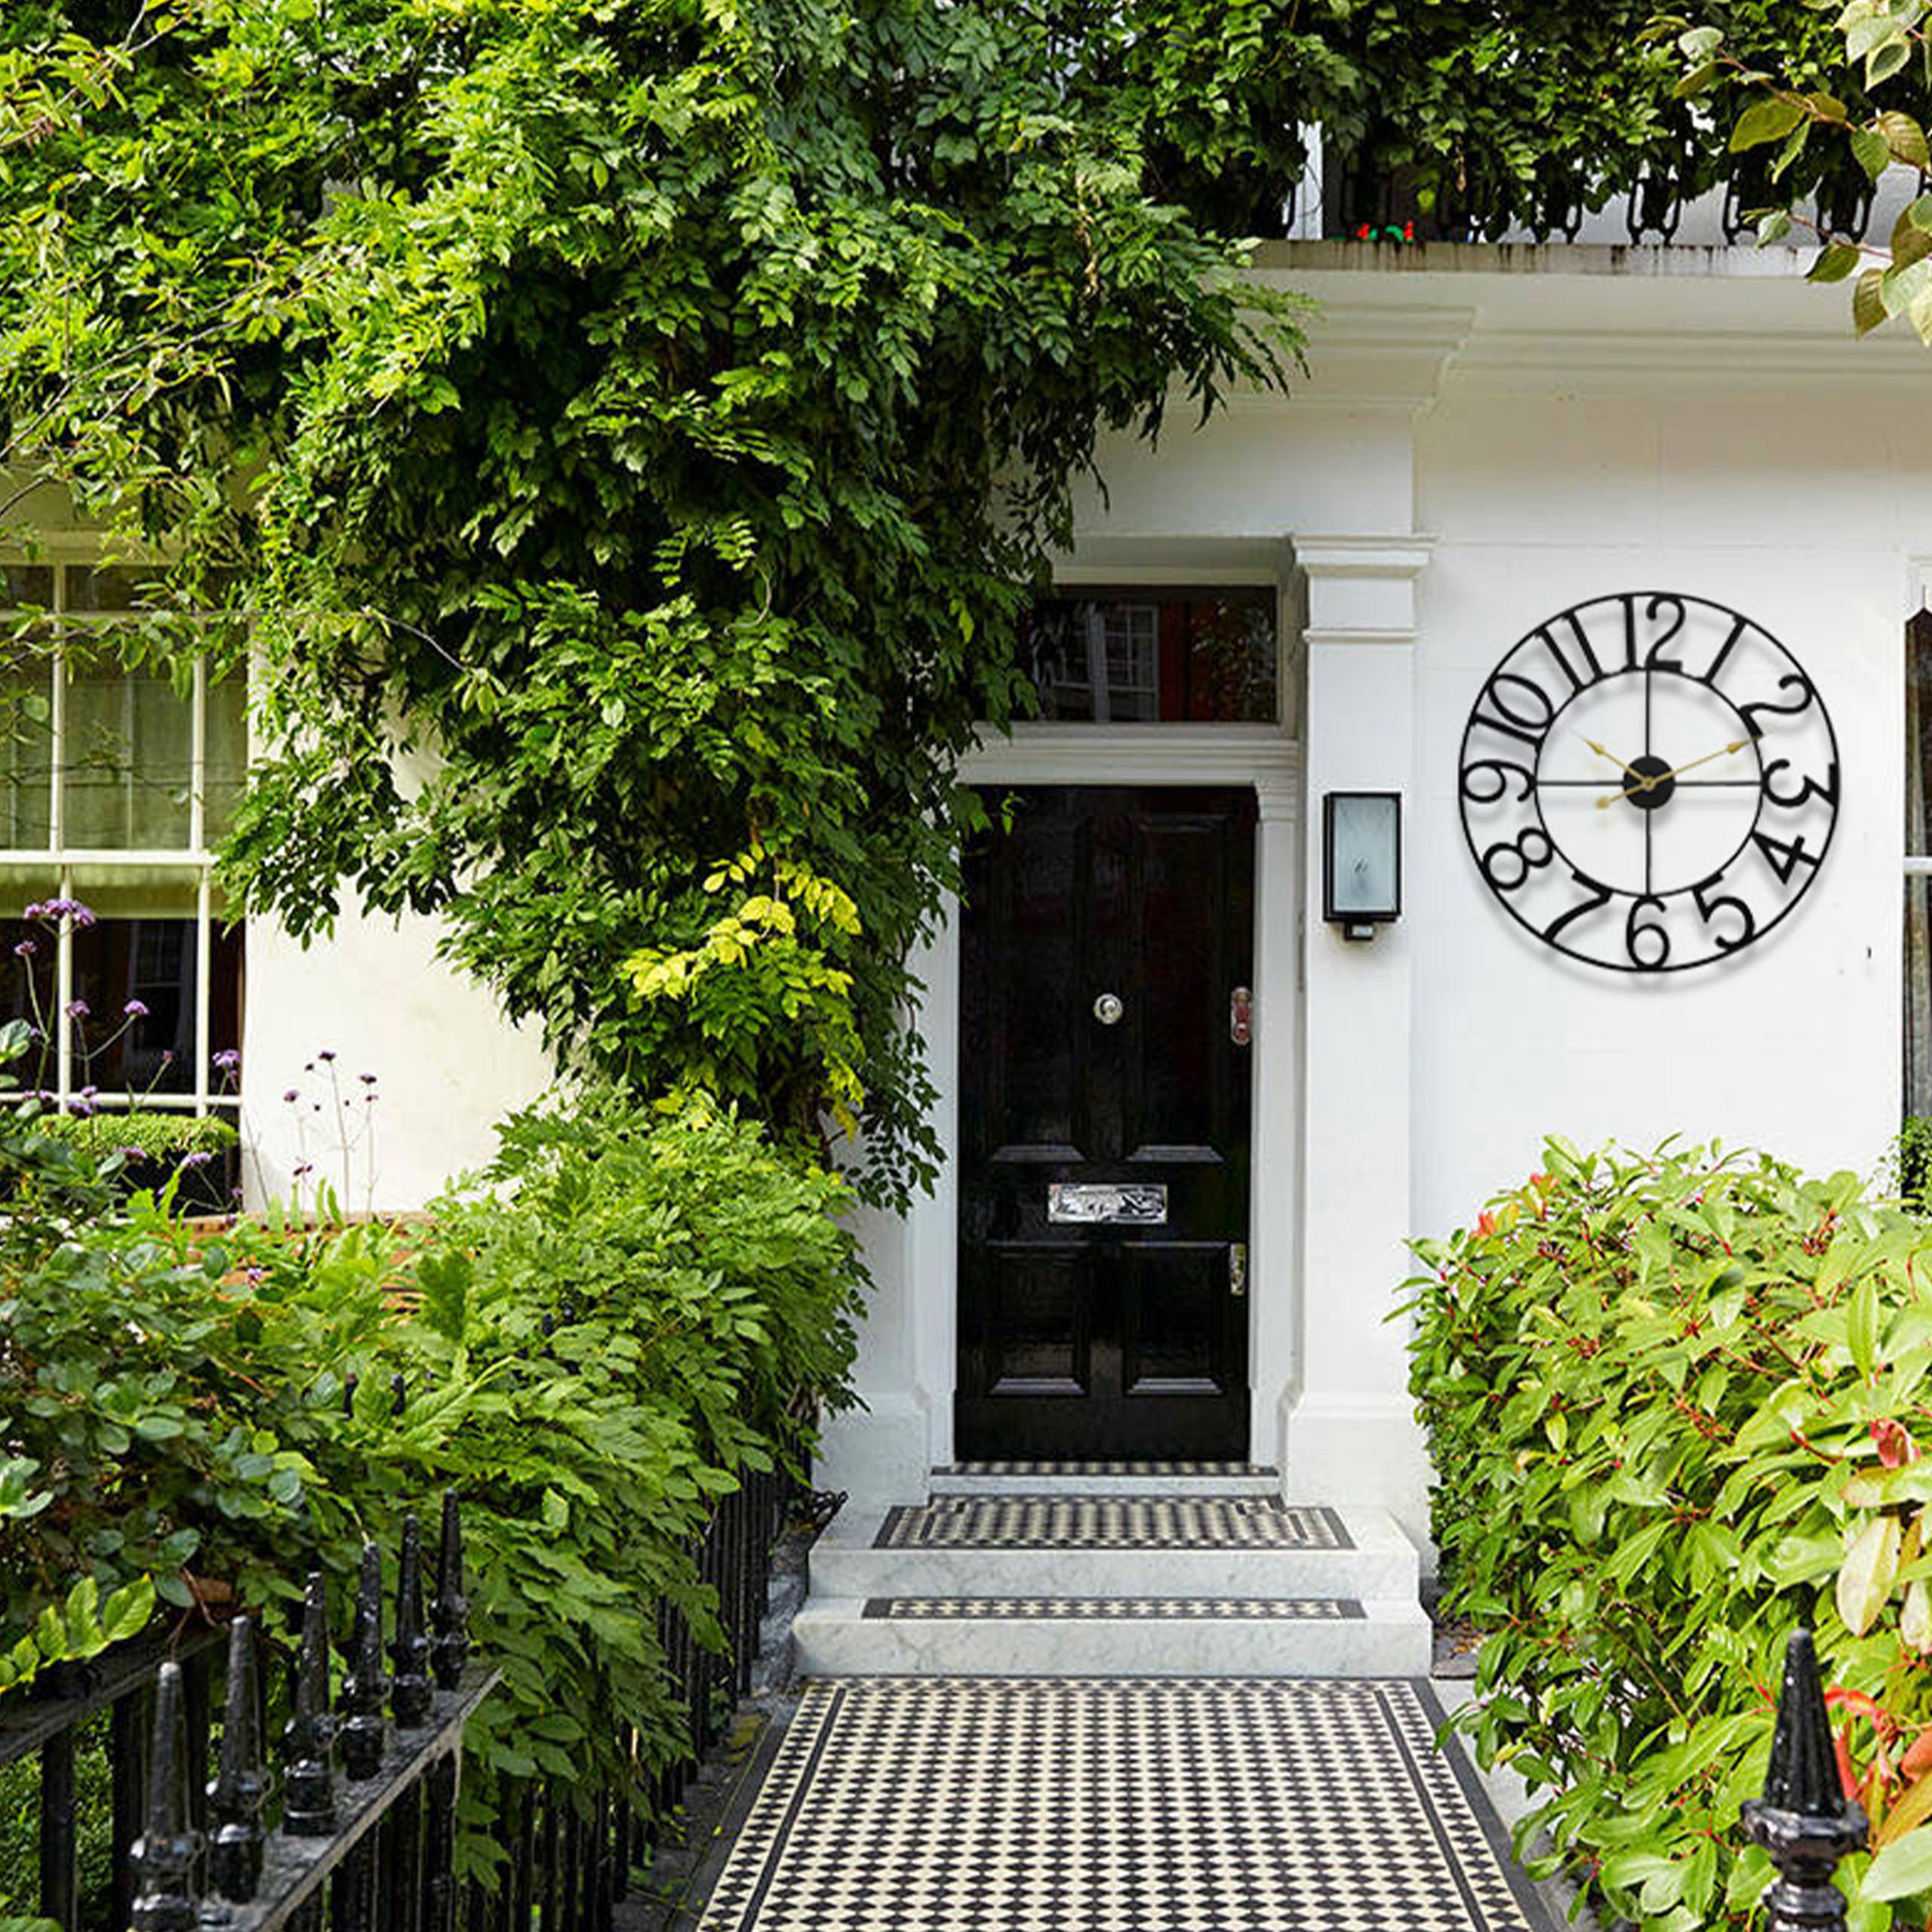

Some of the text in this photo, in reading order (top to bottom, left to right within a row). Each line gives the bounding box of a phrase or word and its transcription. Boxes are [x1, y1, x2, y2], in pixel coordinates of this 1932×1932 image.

[1619, 595, 1685, 671] 12
[1704, 614, 1746, 685] 1
[1471, 674, 1553, 749] 10
[1738, 674, 1813, 740] 2
[1461, 759, 1536, 803] 9
[1762, 758, 1838, 808] 3
[1483, 827, 1553, 891] 8
[1751, 832, 1819, 884] 4
[1544, 869, 1613, 943] 7
[1626, 895, 1670, 969] 6
[1691, 871, 1755, 951] 5
